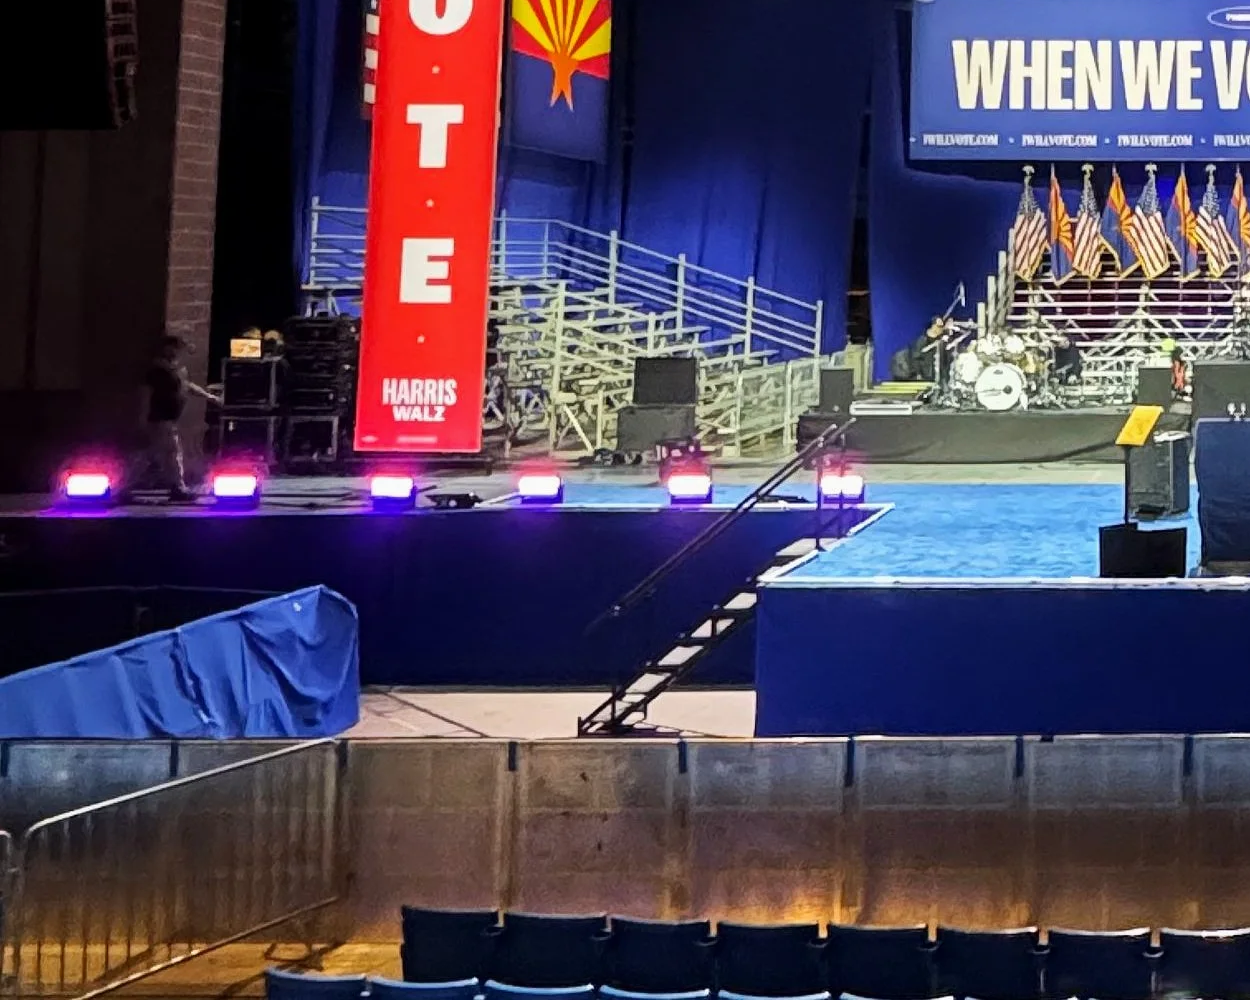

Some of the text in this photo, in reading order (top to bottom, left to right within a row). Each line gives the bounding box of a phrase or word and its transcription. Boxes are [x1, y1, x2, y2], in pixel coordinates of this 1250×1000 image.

[951, 39, 1112, 110] WHEN
[1118, 39, 1203, 110] WE
[382, 378, 458, 406] HARRIS
[392, 405, 446, 422] WALZ
